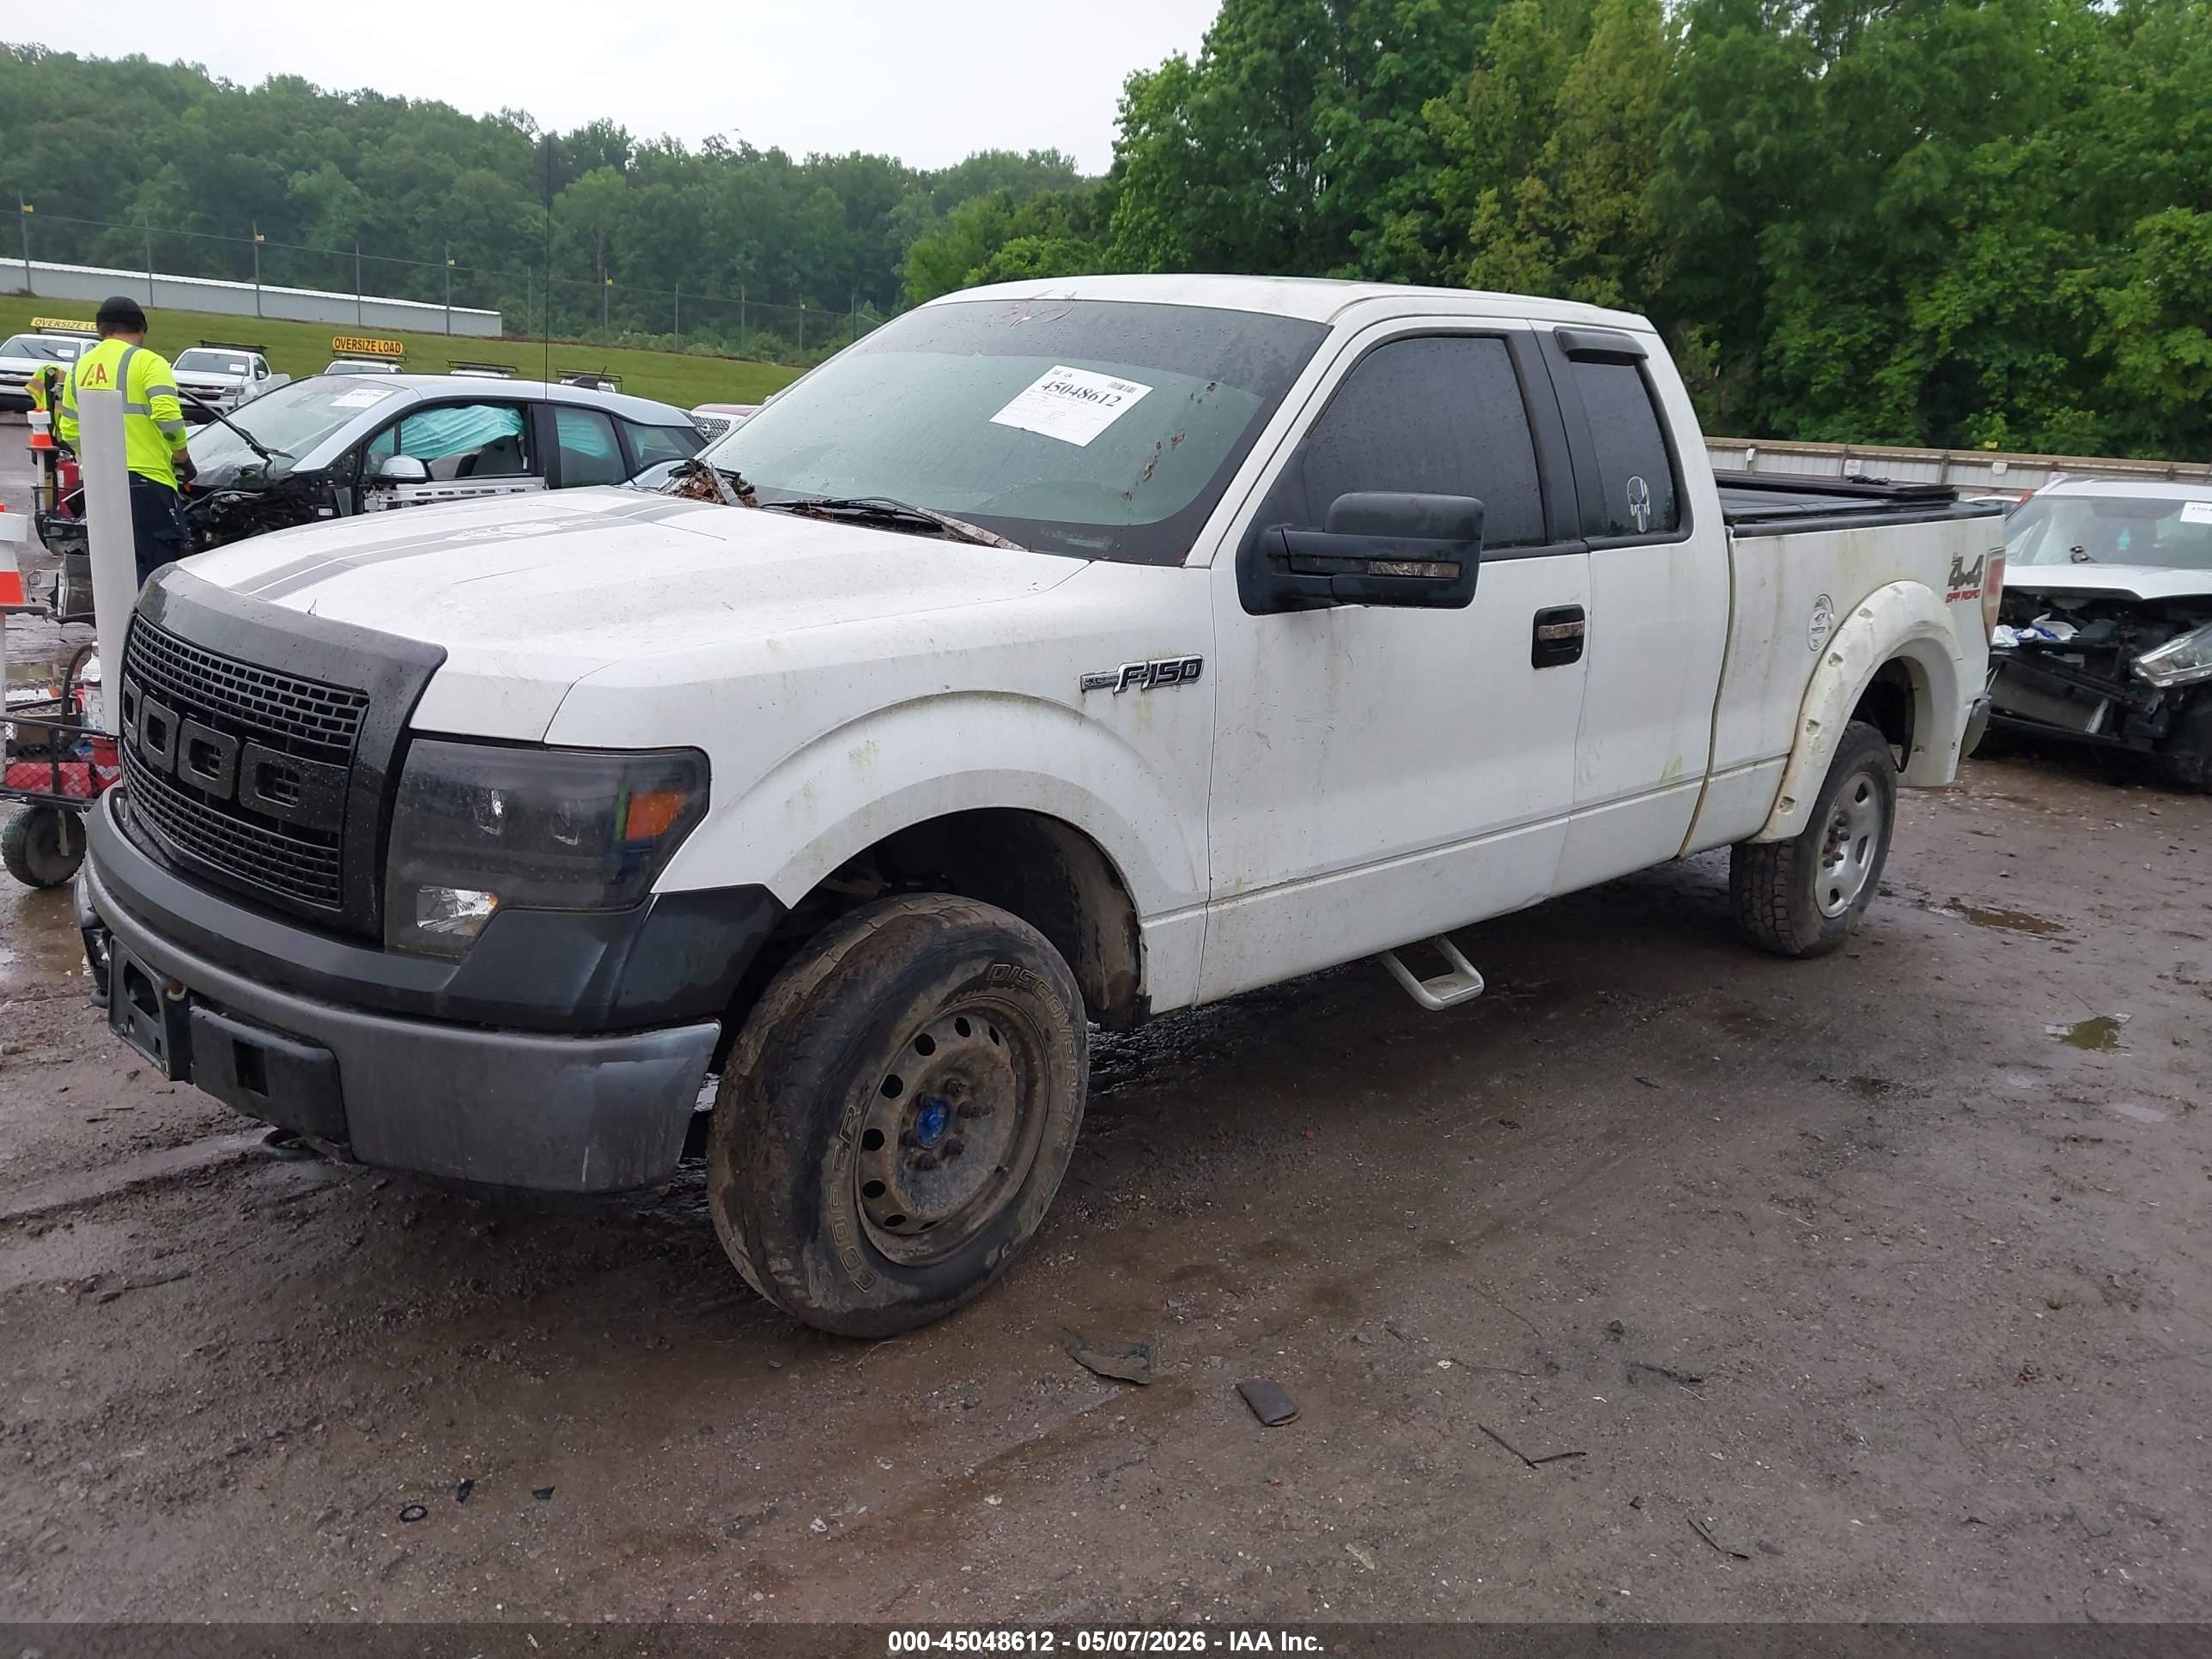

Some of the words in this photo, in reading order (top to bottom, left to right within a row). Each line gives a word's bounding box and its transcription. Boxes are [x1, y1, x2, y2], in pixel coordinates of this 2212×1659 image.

[34, 319, 82, 330] OVERSIZE
[334, 337, 377, 352] OVERSIZE
[378, 342, 401, 354] LOAD
[1042, 380, 1122, 407] 45048612
